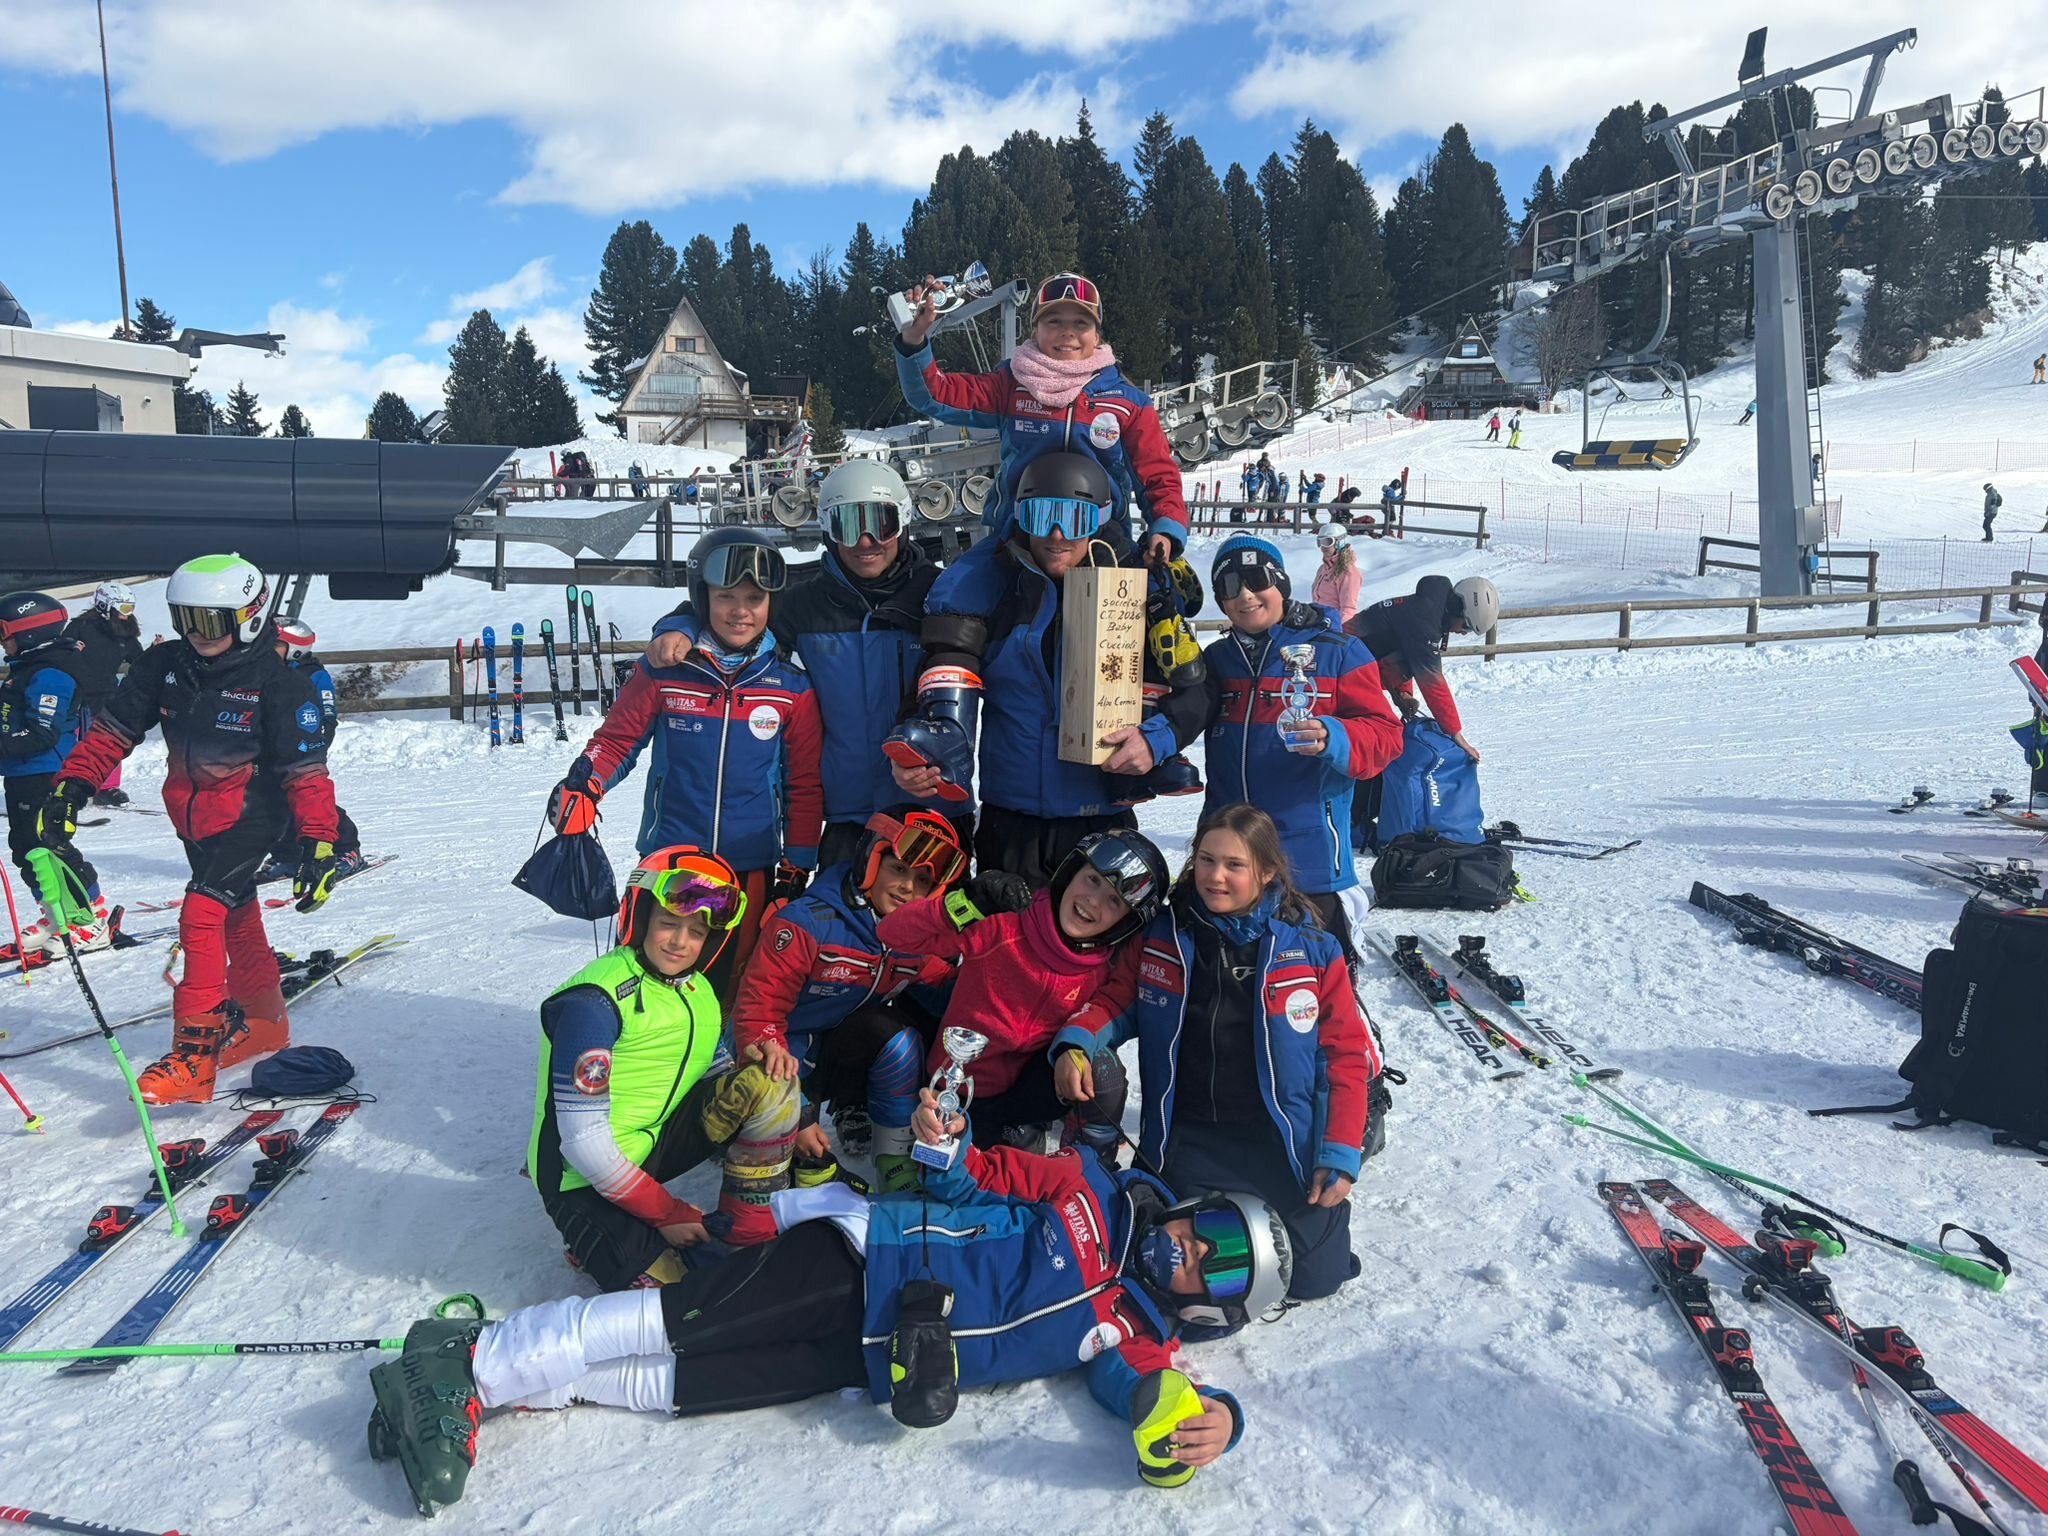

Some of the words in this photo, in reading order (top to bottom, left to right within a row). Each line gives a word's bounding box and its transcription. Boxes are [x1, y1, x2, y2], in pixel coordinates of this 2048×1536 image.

[1025, 400, 1043, 410] ITAS
[1117, 610, 1141, 620] 2026
[1106, 621, 1133, 632] Baby
[1099, 639, 1138, 650] Cuccioli
[1130, 651, 1139, 684] CHINI
[221, 690, 260, 702] SKICLUB
[677, 697, 696, 707] ITAS
[217, 711, 254, 725] OMZ
[1148, 964, 1166, 977] ITAS
[1448, 1018, 1504, 1070] HEAD
[1527, 1017, 1594, 1068] HEAD
[1072, 1209, 1091, 1243] ITAS
